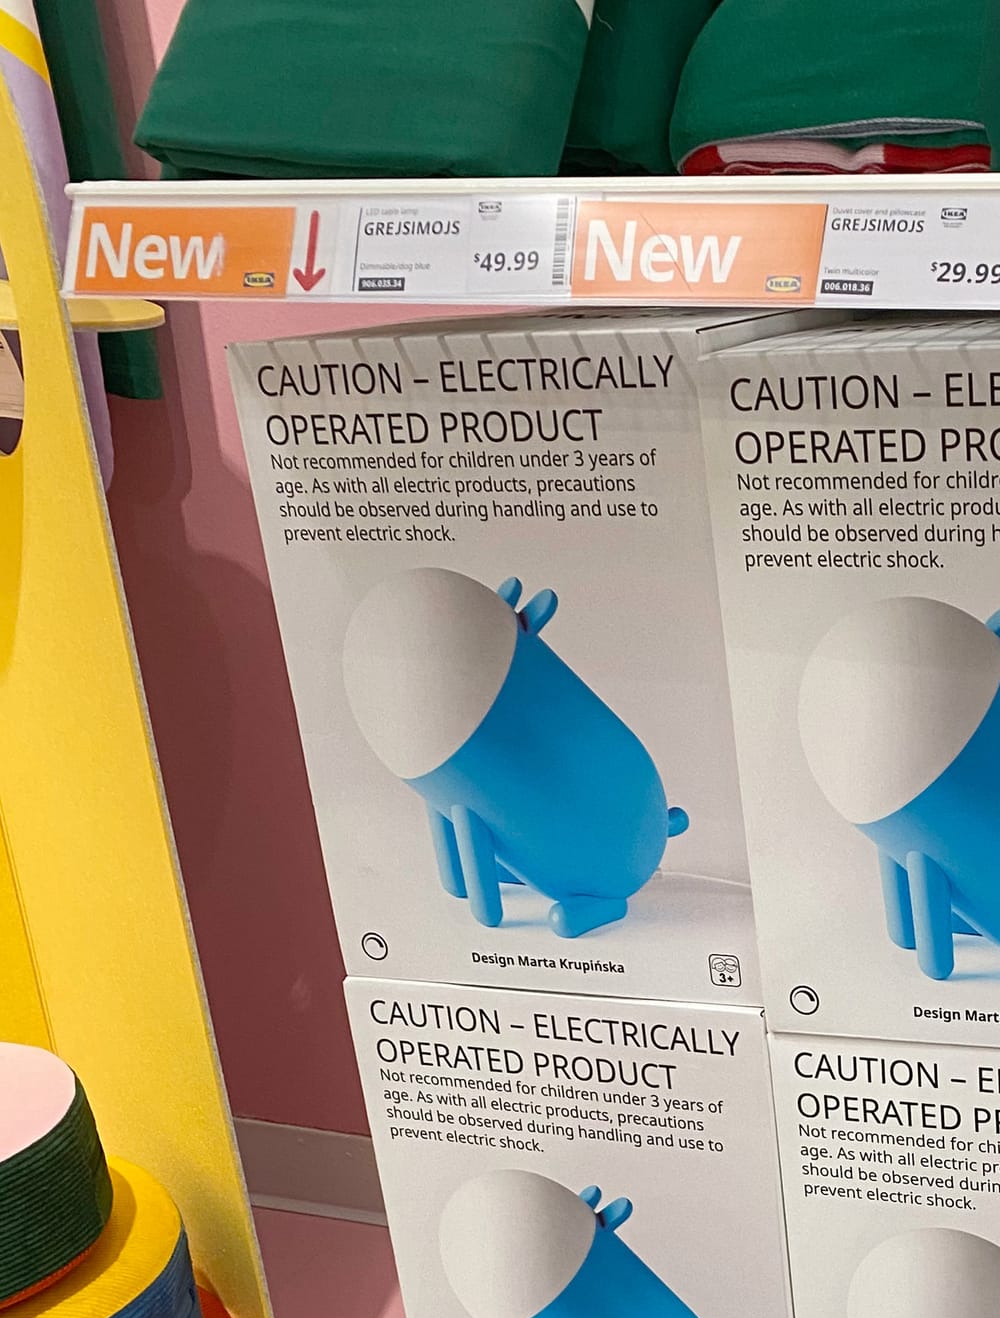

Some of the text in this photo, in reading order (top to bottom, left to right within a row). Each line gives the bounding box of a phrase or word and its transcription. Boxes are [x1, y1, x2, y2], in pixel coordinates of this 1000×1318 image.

[874, 208, 888, 216] and
[364, 221, 461, 236] GREJSIMOJS
[831, 217, 925, 233] GREJSIMOJS
[85, 222, 224, 280] New
[473, 250, 539, 272] $49.99
[584, 219, 743, 283] New
[767, 278, 800, 290] IKEA
[842, 267, 879, 276] multicolor
[824, 283, 870, 292] 006.018.36
[257, 361, 402, 397] CAUTION
[439, 354, 674, 393] ELECTRICALLY
[730, 374, 899, 412] CAUTION
[266, 408, 603, 446] OPERATED PRODUCT
[734, 428, 926, 465] OPERATED
[270, 447, 657, 472] Not recommended for children under 3 years of
[471, 951, 625, 974] Design Marta Krupińska
[717, 970, 735, 983] 3+
[913, 1006, 961, 1023] Design
[369, 999, 501, 1035] CAUTION
[533, 1013, 740, 1056] ELECTRICALLY
[376, 1038, 677, 1090] OPERATED PRODUCT
[794, 1051, 939, 1089] CAUTION
[797, 1092, 961, 1130] OPERATED
